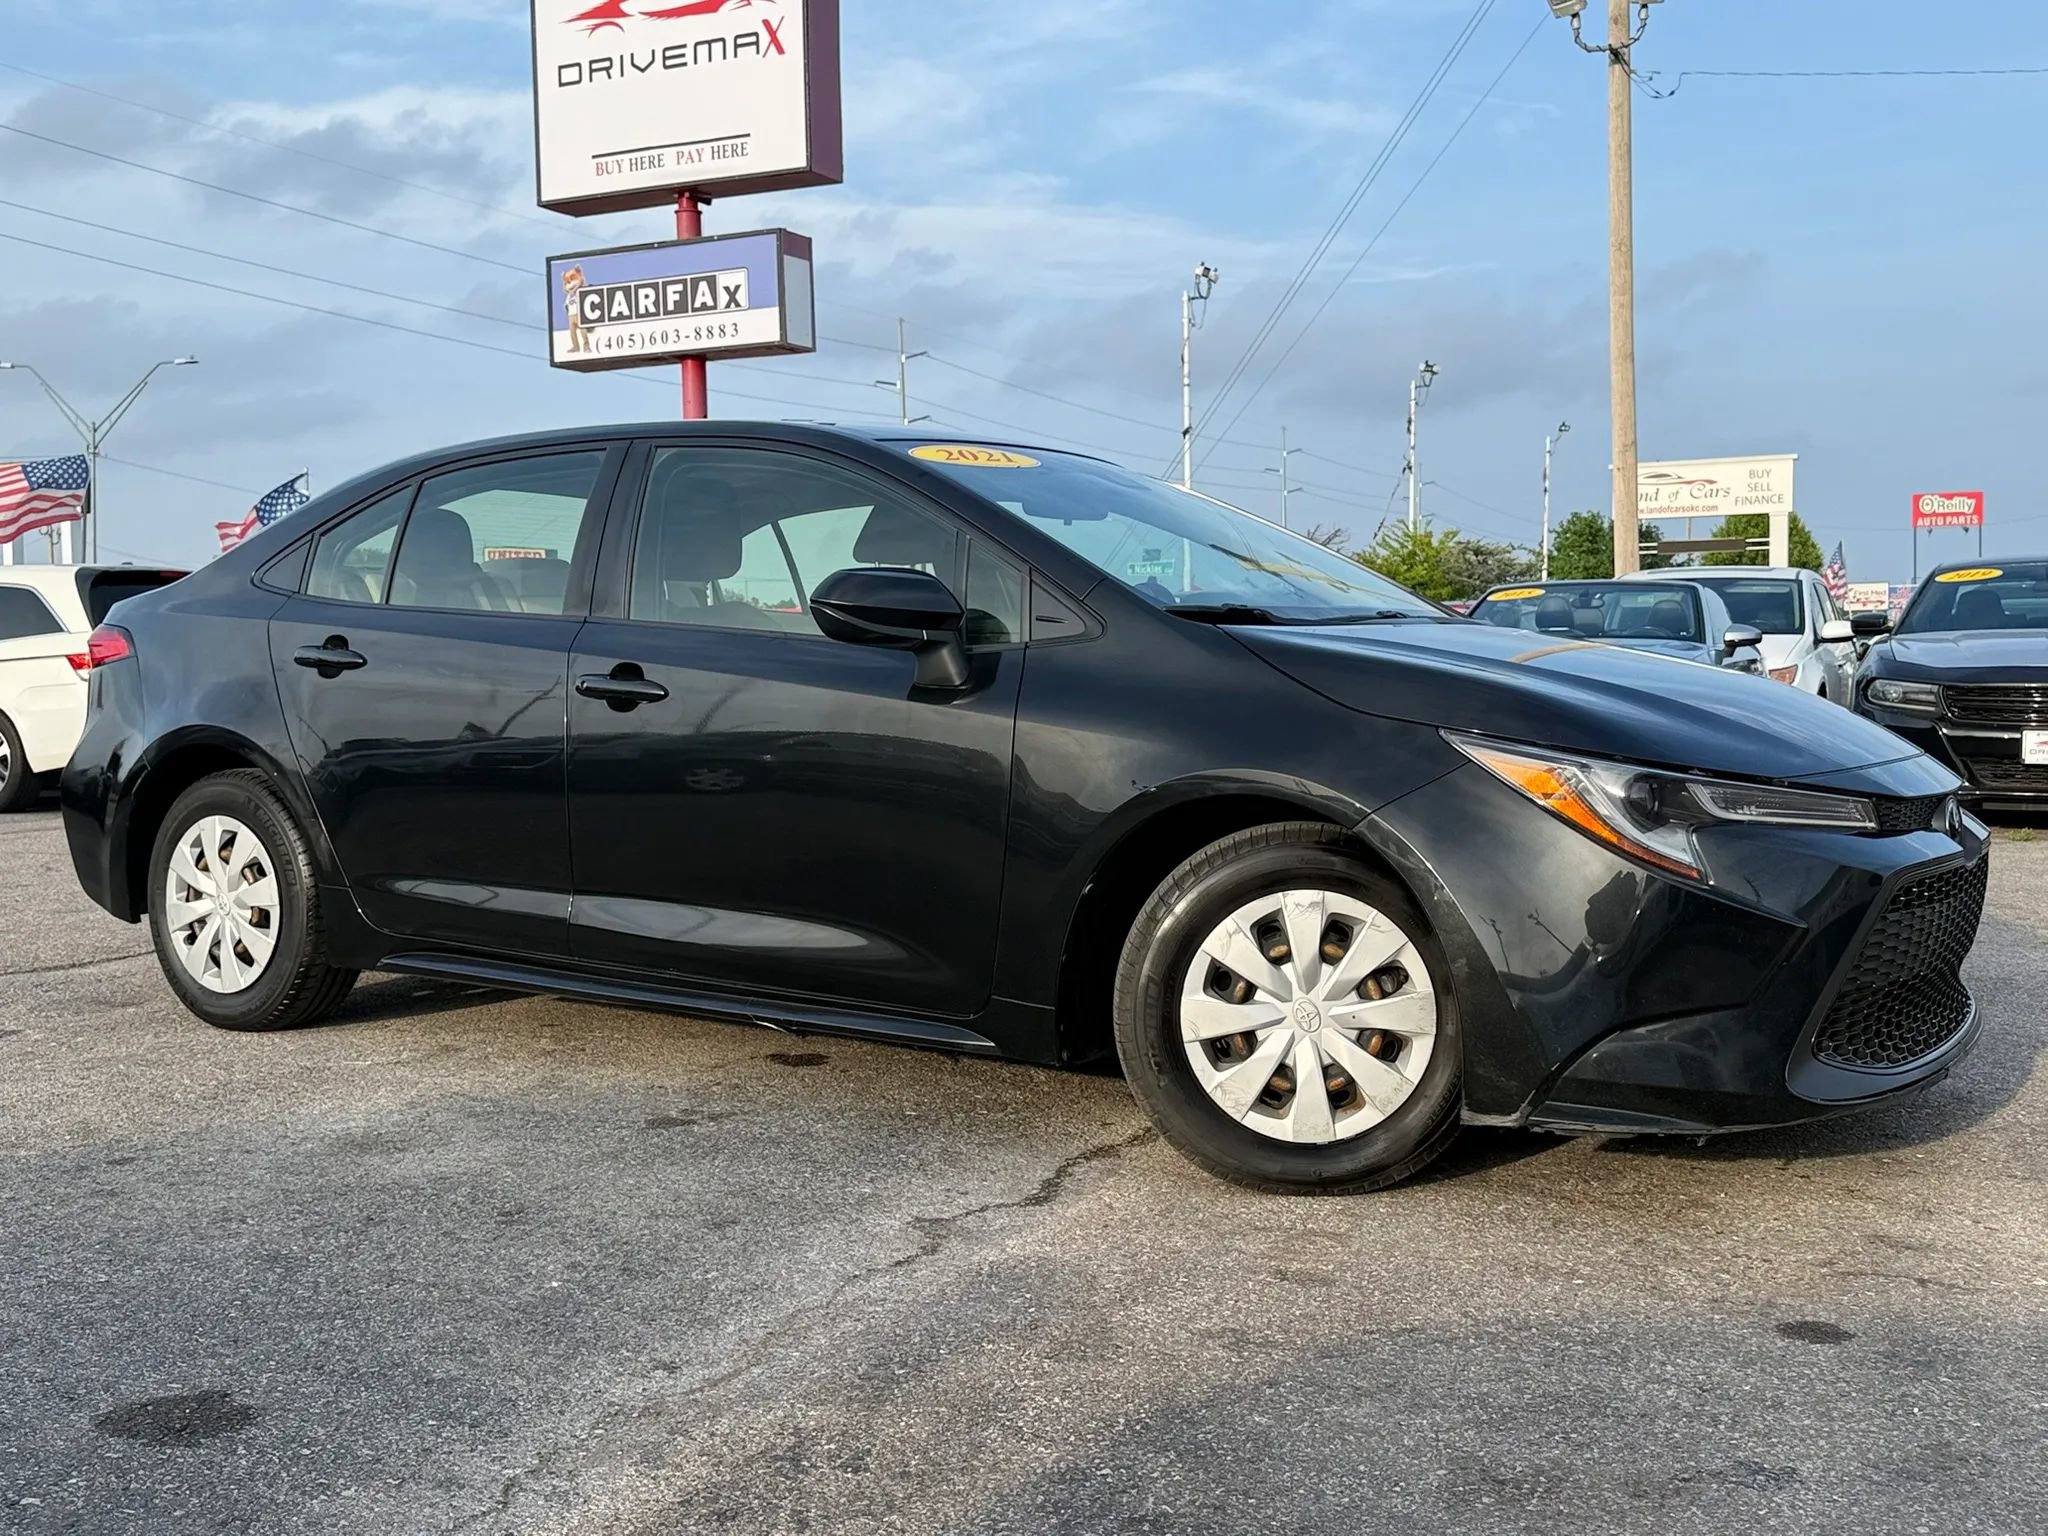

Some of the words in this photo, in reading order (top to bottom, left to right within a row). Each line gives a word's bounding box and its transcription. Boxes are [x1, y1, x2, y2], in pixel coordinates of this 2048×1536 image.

[557, 15, 786, 88] DRIVEMAX
[595, 158, 625, 177] BUY
[629, 153, 665, 173] HERE
[676, 147, 705, 166] PAY
[710, 141, 749, 161] HERE
[583, 280, 742, 321] CARFAX
[595, 321, 739, 354] (405)603-8883
[935, 448, 1017, 463] 2021
[1748, 468, 1772, 480] BUY
[1638, 487, 1660, 502] nd
[1667, 486, 1683, 503] of
[1689, 482, 1731, 500] Cars
[1747, 481, 1773, 493] SELL
[1734, 493, 1785, 507] FINANCE
[1920, 495, 1974, 513] O'Reilly
[1638, 503, 1719, 515] w.landofcarsokc.com
[1916, 516, 1945, 527] AUTO
[1945, 514, 1979, 525] PARTS
